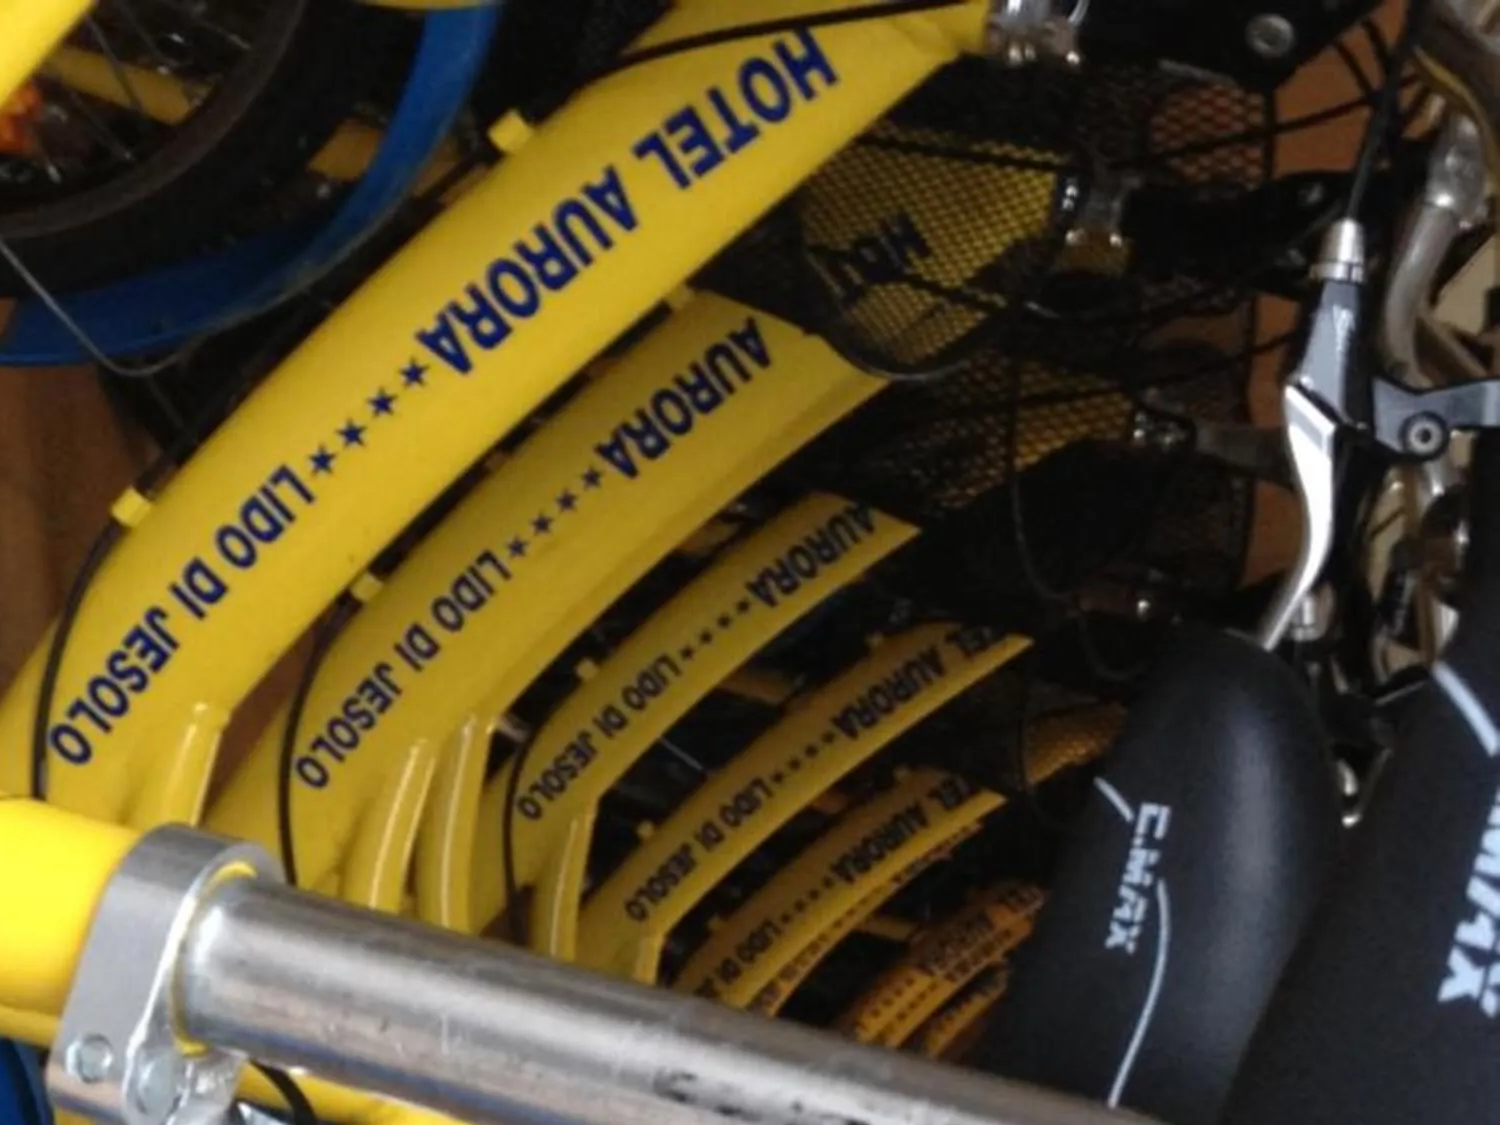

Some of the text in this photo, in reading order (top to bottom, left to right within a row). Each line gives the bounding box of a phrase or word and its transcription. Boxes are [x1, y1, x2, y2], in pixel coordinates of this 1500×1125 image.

[49, 27, 840, 766] HOTEL AURORA LIDO DI JESOLO
[595, 317, 772, 480] AURORA
[430, 548, 513, 632] LIDO
[394, 623, 441, 672] DI
[518, 502, 877, 821] AURORA LIDO DI JESOLO
[830, 643, 949, 740] AURORA
[295, 662, 402, 789] JESOLO
[625, 842, 698, 923] JESOLO
